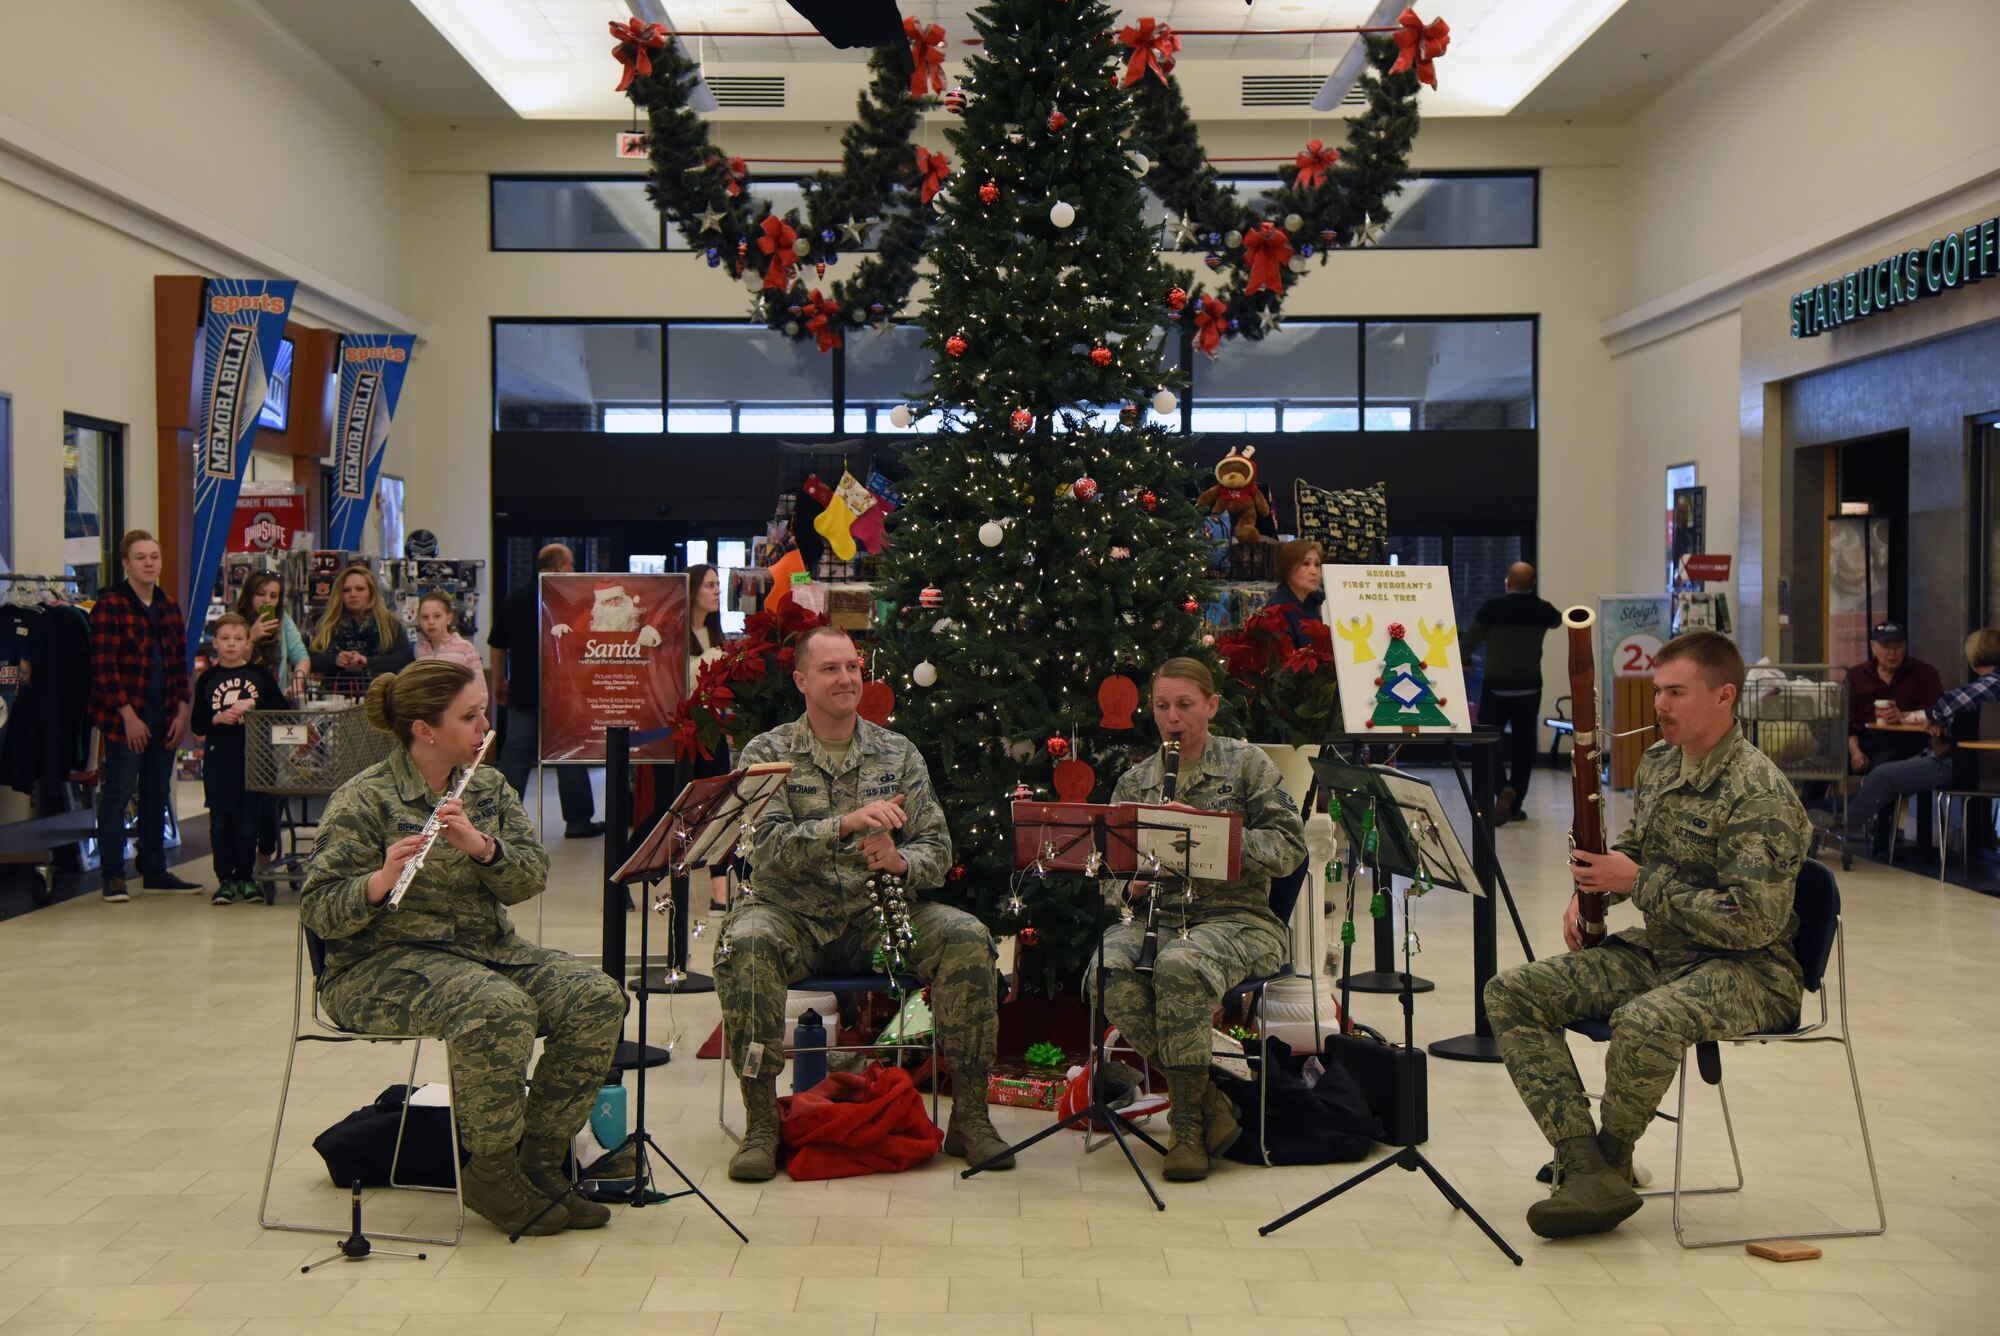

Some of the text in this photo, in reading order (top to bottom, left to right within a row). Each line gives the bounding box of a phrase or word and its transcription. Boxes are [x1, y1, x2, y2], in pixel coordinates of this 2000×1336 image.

[1790, 217, 2000, 339] STARBUCKS COFF
[212, 293, 285, 315] sports
[345, 345, 406, 363] sports
[211, 331, 250, 472] MEMORABILIA
[344, 376, 377, 493] MEMORABILIA
[1366, 570, 1407, 578] KEESLER
[1377, 582, 1432, 590] SERGEANT'S
[1393, 594, 1417, 602] TREE
[584, 639, 641, 658] Santa
[212, 677, 241, 710] DEFEND
